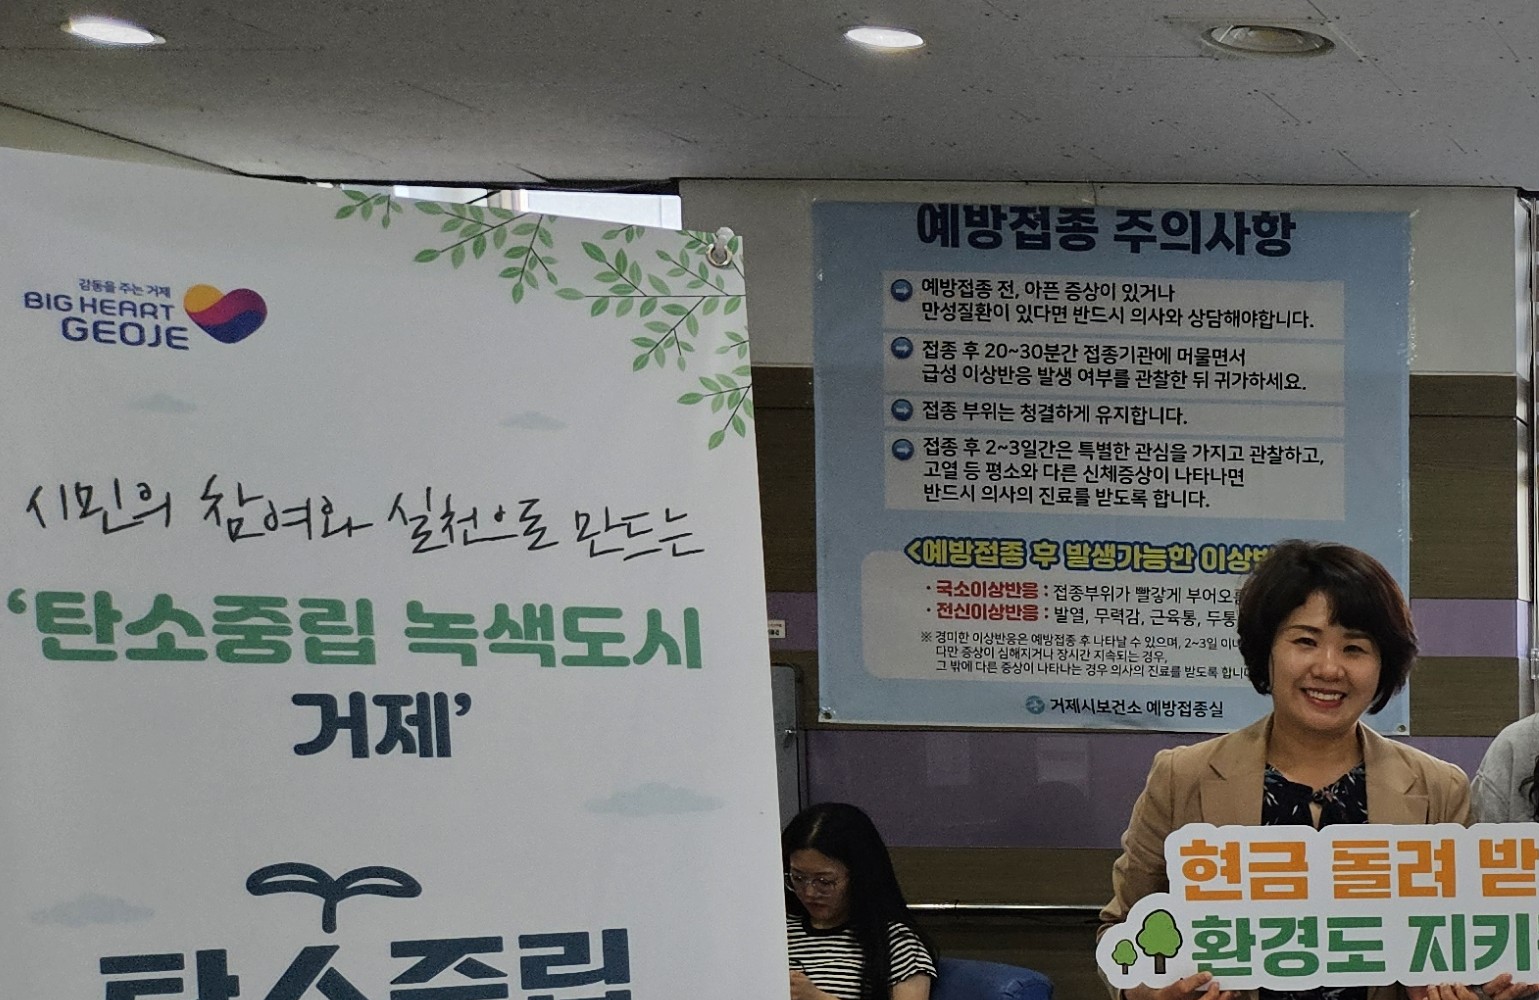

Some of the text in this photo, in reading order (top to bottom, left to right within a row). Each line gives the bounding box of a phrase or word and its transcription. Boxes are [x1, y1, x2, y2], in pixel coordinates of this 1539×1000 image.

[917, 203, 1296, 257] 예방접종 주의사항
[79, 278, 171, 298] 감동을 주는 거제
[921, 278, 1175, 303] 예방접종 아픈 증상이 있거나
[24, 291, 175, 321] BIG HEART
[922, 302, 1314, 329] 만성질환이 있다면 반드시 의사와 상담해야합니다.
[62, 316, 189, 350] GEOJE
[922, 340, 1246, 367] 접종 후 20~30분간 접종기관에 머물면서
[922, 364, 1307, 391] 급성 이상반응 발생 여부를 관찰한 뒤 귀가하세요.
[922, 400, 1188, 426] 접종 부위는 청결하게 유지합니다.
[923, 437, 1324, 466] 접종 후 2~3일간은 특별한 관심을 가지고 관찰하고,
[923, 460, 1244, 487] 고열 등 평소와 다른 신체증상이 나타나면
[924, 483, 1210, 509] 반드시 의사의 진료를 받도록 합니다.
[25, 474, 706, 560] 시민의 참여와 실천으로 만드는
[1064, 539, 1198, 573] 발생가능한
[936, 580, 1182, 604] 국소이상반응 접종부위가 빨갛게
[936, 602, 1201, 627] 전신이상반응 발열, 무력감, 근육통,
[405, 600, 702, 670] 녹색도시
[935, 631, 1127, 649] 경미한 이상반응은 예방접종 나타날
[961, 646, 1139, 663] 증상이 심해지거나 지속되는
[1001, 662, 1144, 677] 증상이 나타나는 의사의
[1051, 698, 1223, 718] 거제시보건소 예방접종실
[1180, 838, 1309, 902] 현금
[1332, 838, 1458, 899] 돌려
[1192, 914, 1387, 978] 환경도
